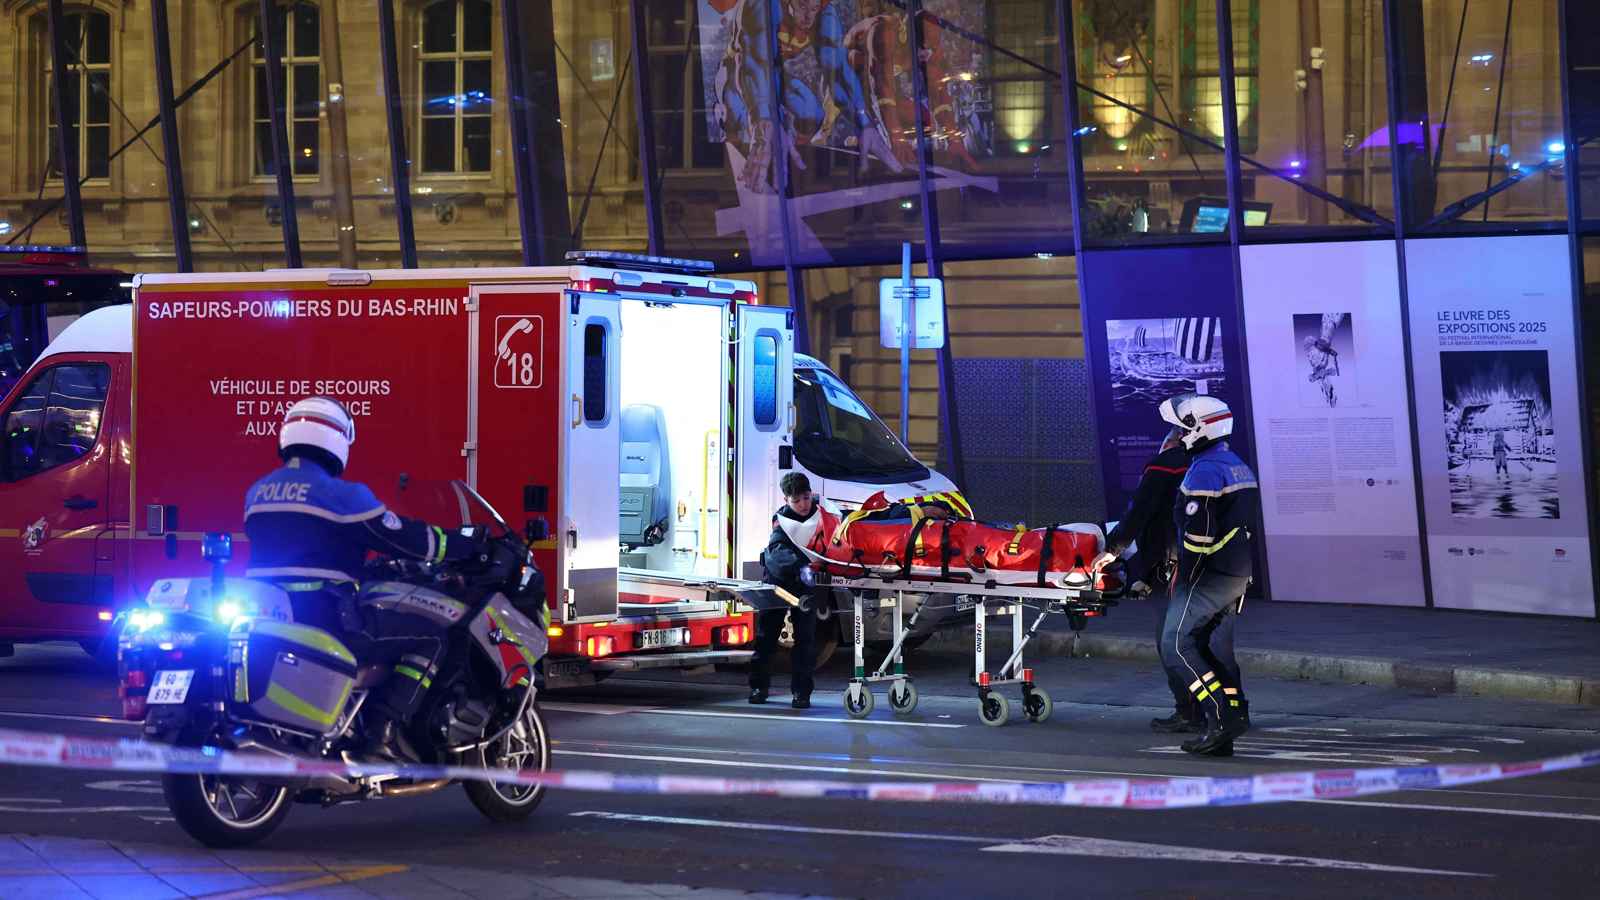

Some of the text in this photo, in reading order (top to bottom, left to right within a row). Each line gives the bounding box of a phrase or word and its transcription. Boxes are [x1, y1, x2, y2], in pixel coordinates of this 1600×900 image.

[337, 299, 362, 317] DU
[368, 298, 458, 317] BAS-RHIN
[1437, 310, 1511, 321] LE LIVRE DES
[1438, 322, 1547, 333] EXPOSITIONS 2025
[508, 352, 533, 385] 18
[210, 377, 391, 395] VÉHICULE DE SECOURS
[236, 401, 256, 415] ET
[245, 421, 277, 436] AUX
[254, 483, 311, 502] POLICE
